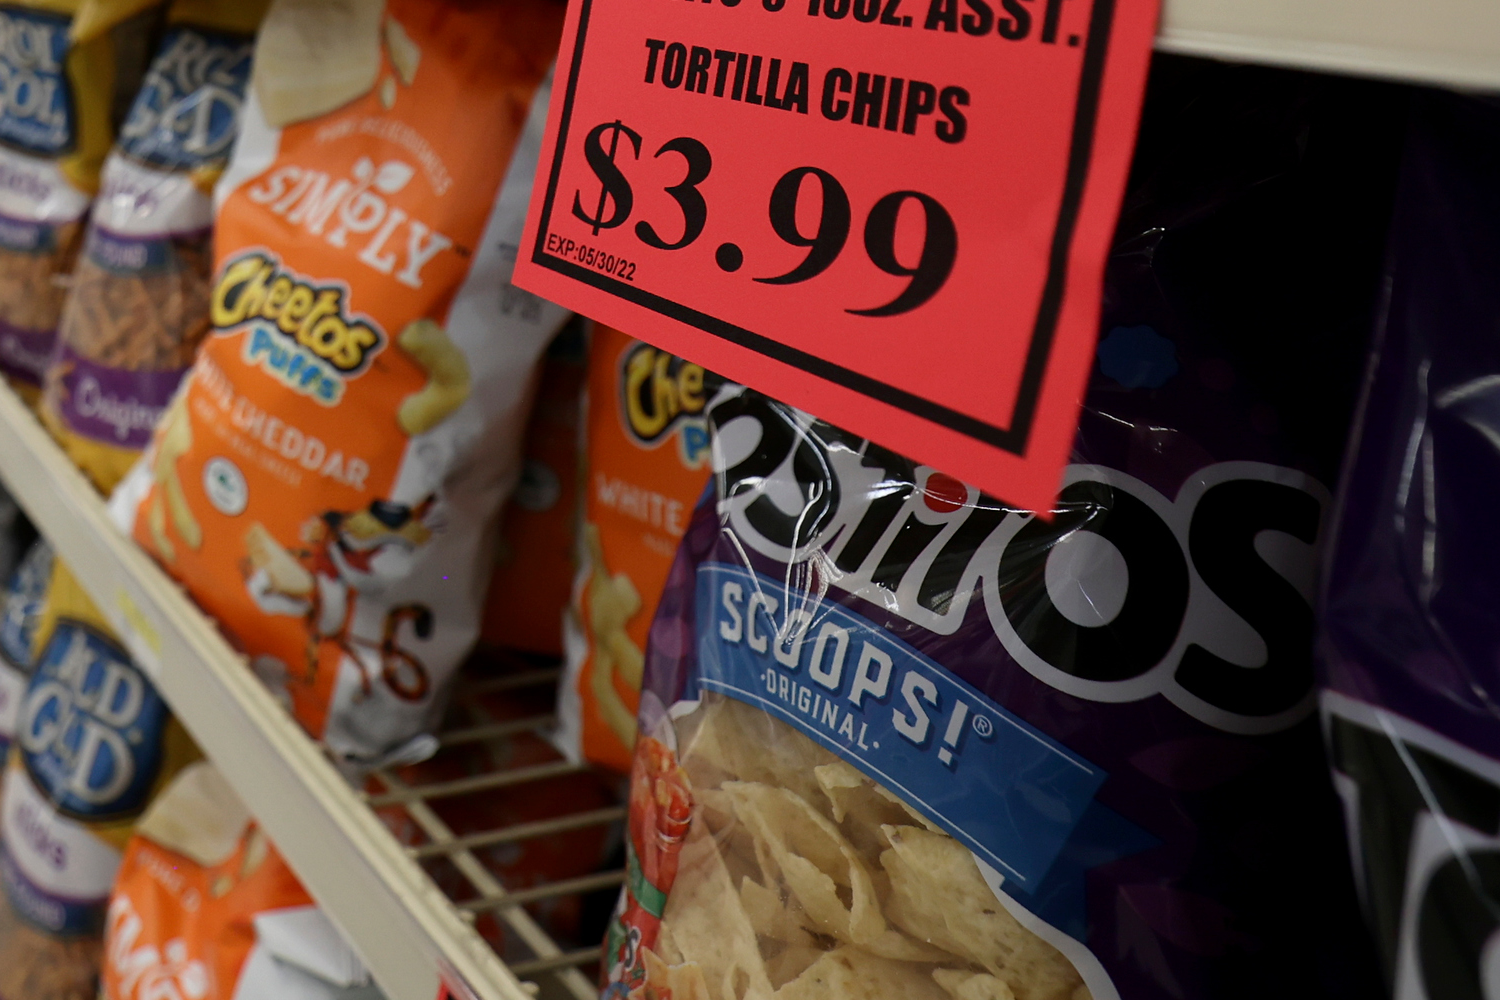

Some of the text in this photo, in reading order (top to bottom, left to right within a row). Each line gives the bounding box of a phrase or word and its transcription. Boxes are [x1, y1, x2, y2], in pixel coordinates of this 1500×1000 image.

[644, 38, 970, 144] TORTILLA CHIPS
[248, 165, 453, 289] SIMPLY
[546, 232, 637, 281] EXP:05/30/22
[571, 119, 959, 318] $3.99
[209, 254, 381, 371] Cheetos
[248, 326, 340, 401] Puffs
[231, 394, 370, 491] CHEDDAR
[595, 473, 686, 538] WHITE
[719, 581, 970, 768] SCOOPS!
[765, 667, 870, 752] ORIGINAL
